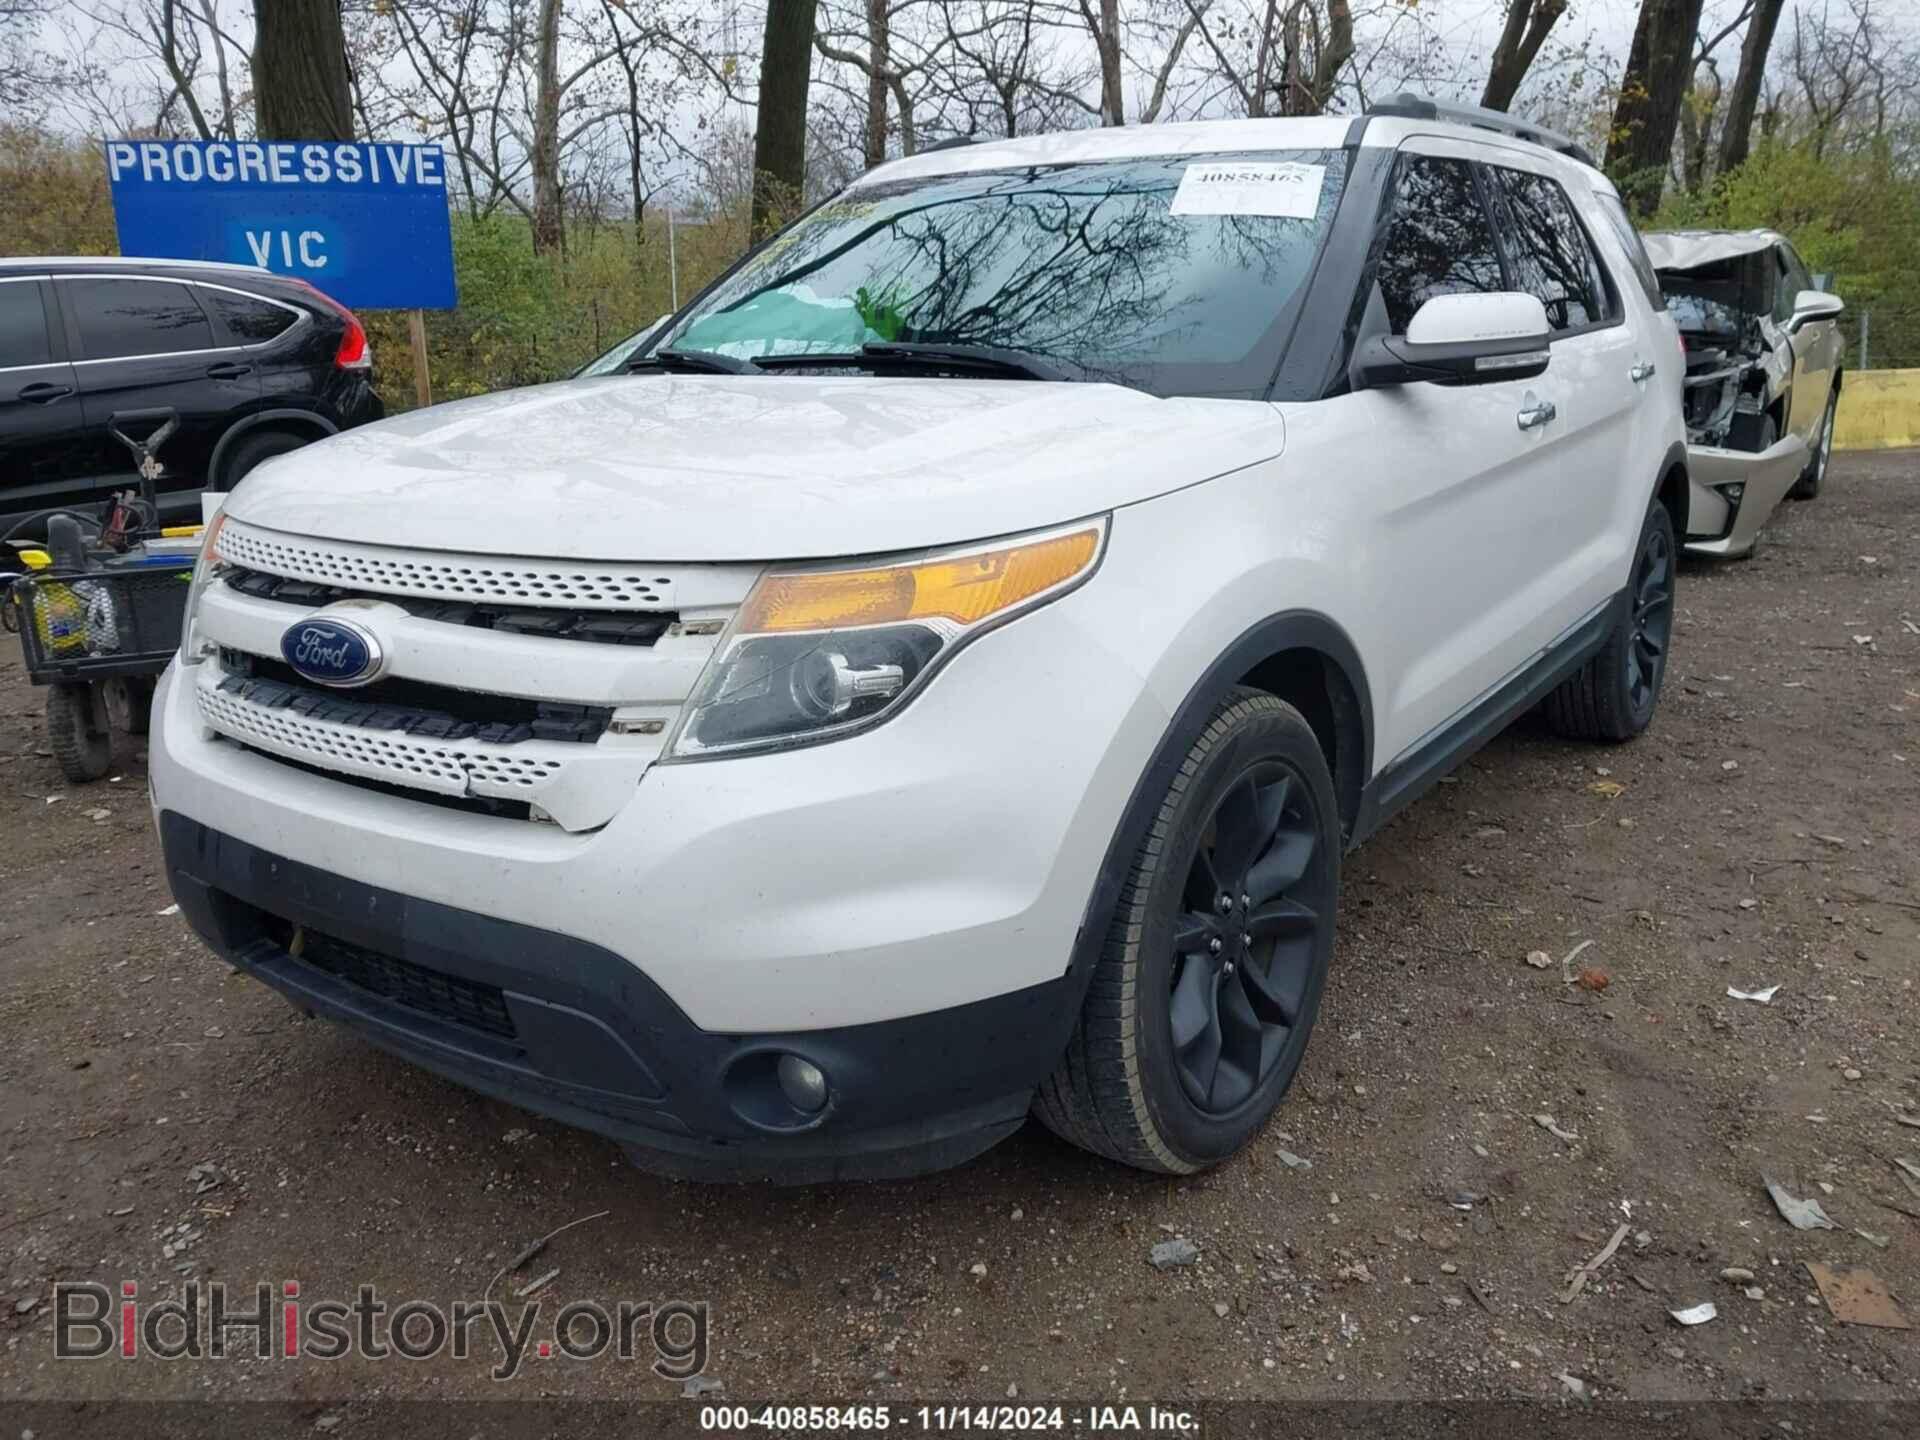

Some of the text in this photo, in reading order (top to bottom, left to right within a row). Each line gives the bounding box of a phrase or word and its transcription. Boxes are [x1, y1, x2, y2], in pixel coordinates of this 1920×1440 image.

[108, 143, 443, 184] PROGRESSIVE
[1196, 172, 1304, 184] 40858465
[245, 230, 328, 268] VIC
[295, 627, 349, 669] Ford
